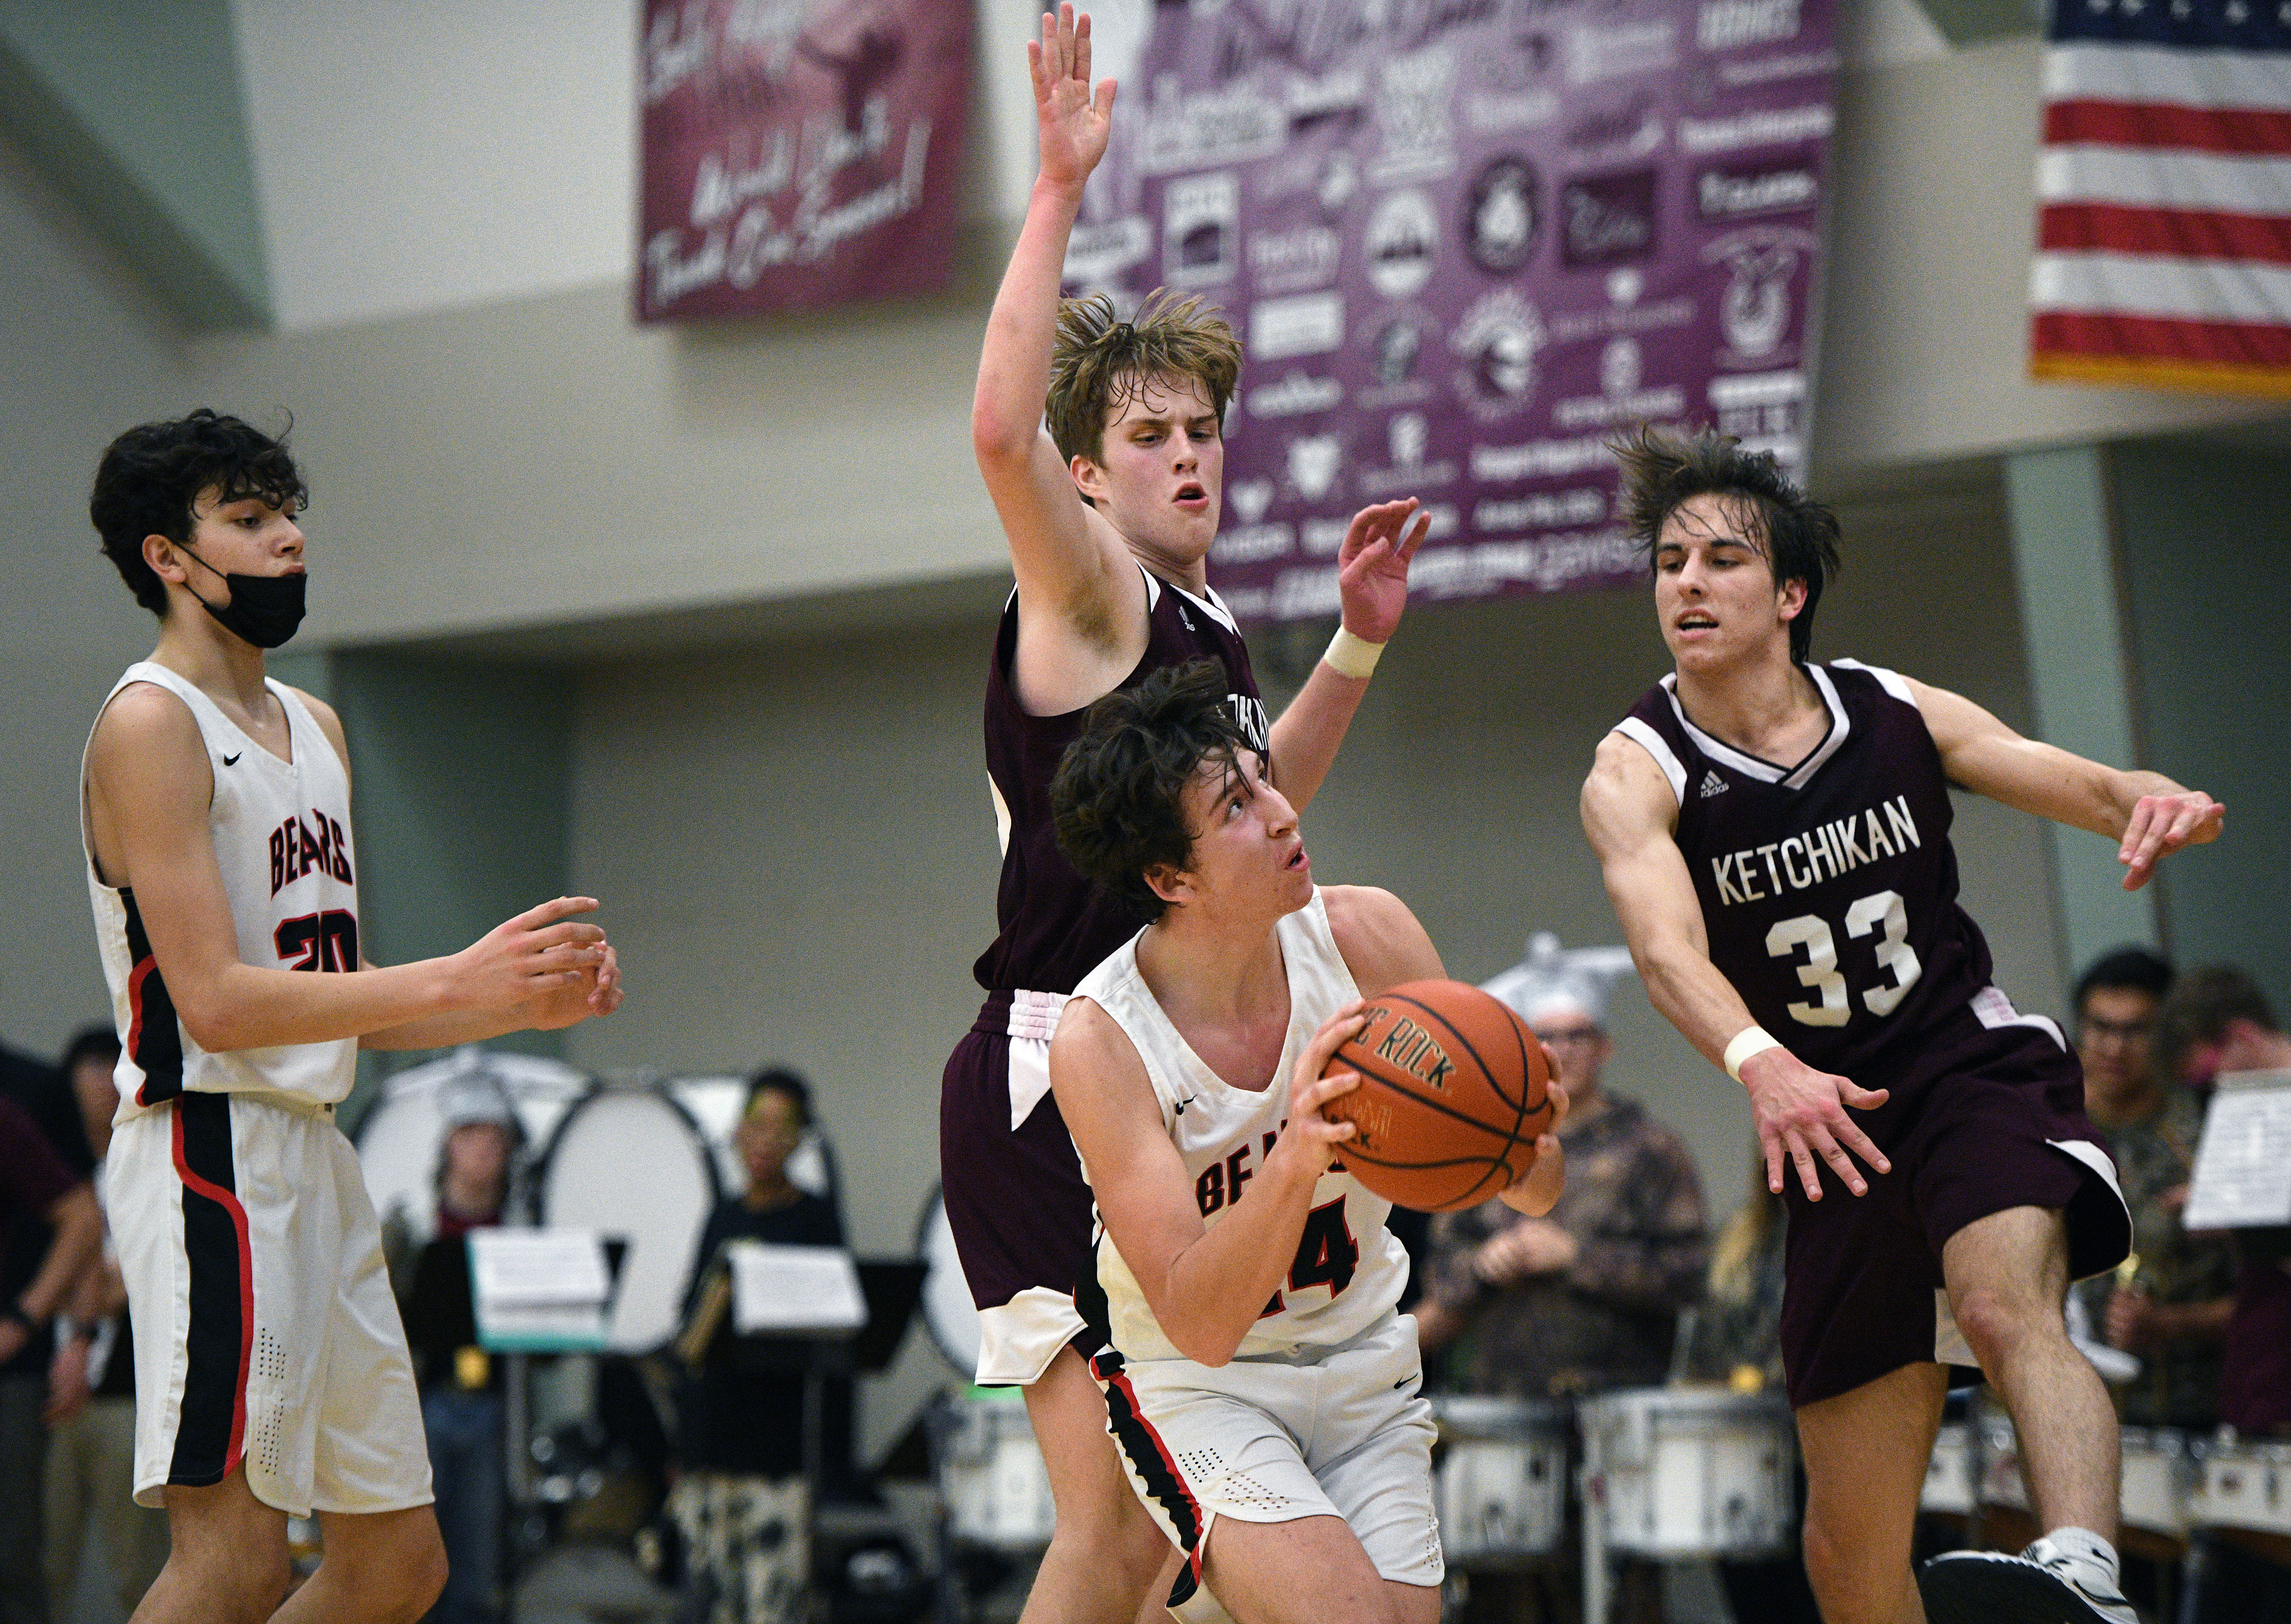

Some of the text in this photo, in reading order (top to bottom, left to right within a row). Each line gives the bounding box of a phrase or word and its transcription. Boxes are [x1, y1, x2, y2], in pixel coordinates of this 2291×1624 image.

[268, 807, 353, 901] BEARS
[1711, 794, 1921, 906] KETCHIKAN
[1764, 889, 1923, 1028] 33
[1375, 1014, 1457, 1091] ROCK
[1257, 1192, 1360, 1320] 4
